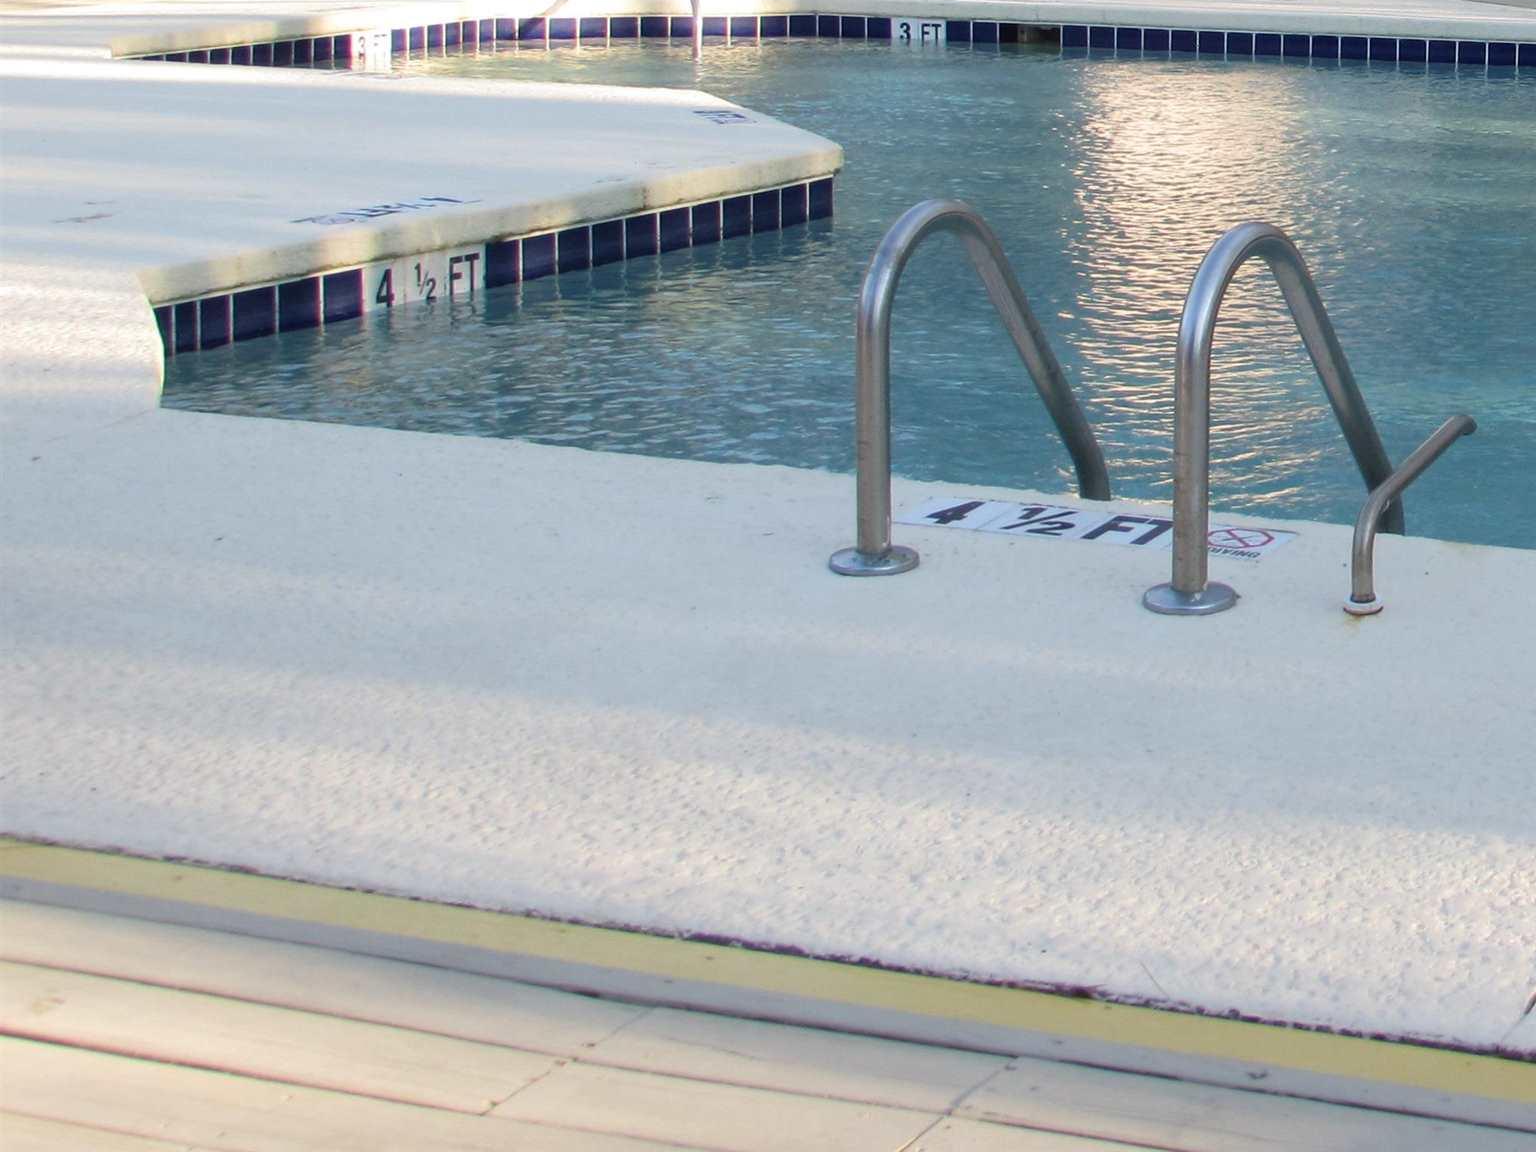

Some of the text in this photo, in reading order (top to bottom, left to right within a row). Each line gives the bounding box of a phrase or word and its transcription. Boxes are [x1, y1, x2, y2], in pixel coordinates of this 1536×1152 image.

[900, 22, 942, 41] 3 FT
[376, 268, 394, 308] 4
[450, 252, 480, 298] FT
[926, 501, 986, 524] 4
[1081, 515, 1174, 545] FT
